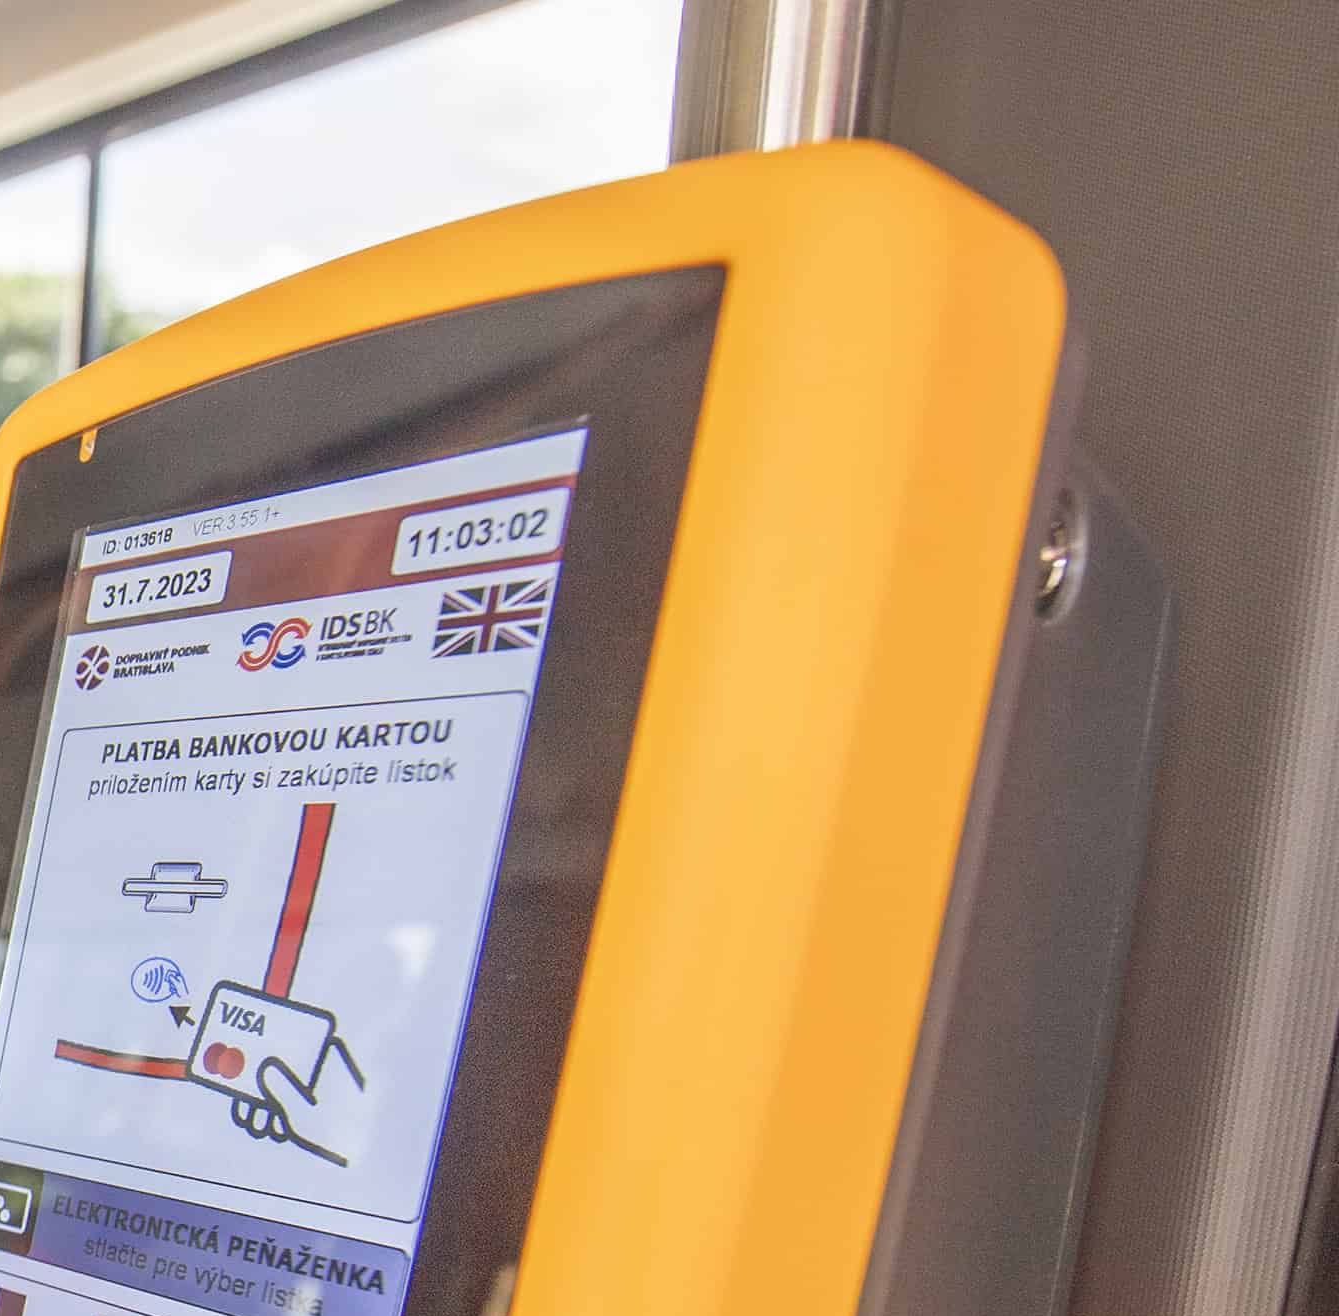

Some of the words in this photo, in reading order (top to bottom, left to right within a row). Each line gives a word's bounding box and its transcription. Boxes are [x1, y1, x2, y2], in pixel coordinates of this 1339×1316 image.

[102, 541, 121, 556] ID:
[124, 528, 173, 551] 013618
[193, 517, 224, 537] VER
[409, 508, 549, 557] 11:03:02
[103, 568, 212, 609] 31.7.2023
[113, 661, 175, 679] BRATISLAVA
[101, 740, 181, 764] PLATBA
[188, 728, 326, 759] BANKOVOU
[335, 719, 454, 749] KARTOU
[87, 771, 187, 800] priložením
[194, 768, 245, 796] karty
[252, 766, 272, 788] si
[277, 762, 379, 792] zakúpite
[387, 756, 459, 783] lístok
[220, 1002, 266, 1037] VISA
[52, 1194, 220, 1254] ELEKTRONICKÁ
[227, 1236, 385, 1295] PEŇAŽENKA
[83, 1237, 147, 1270] stlačte
[152, 1256, 188, 1281] pre
[194, 1265, 256, 1298] výber
